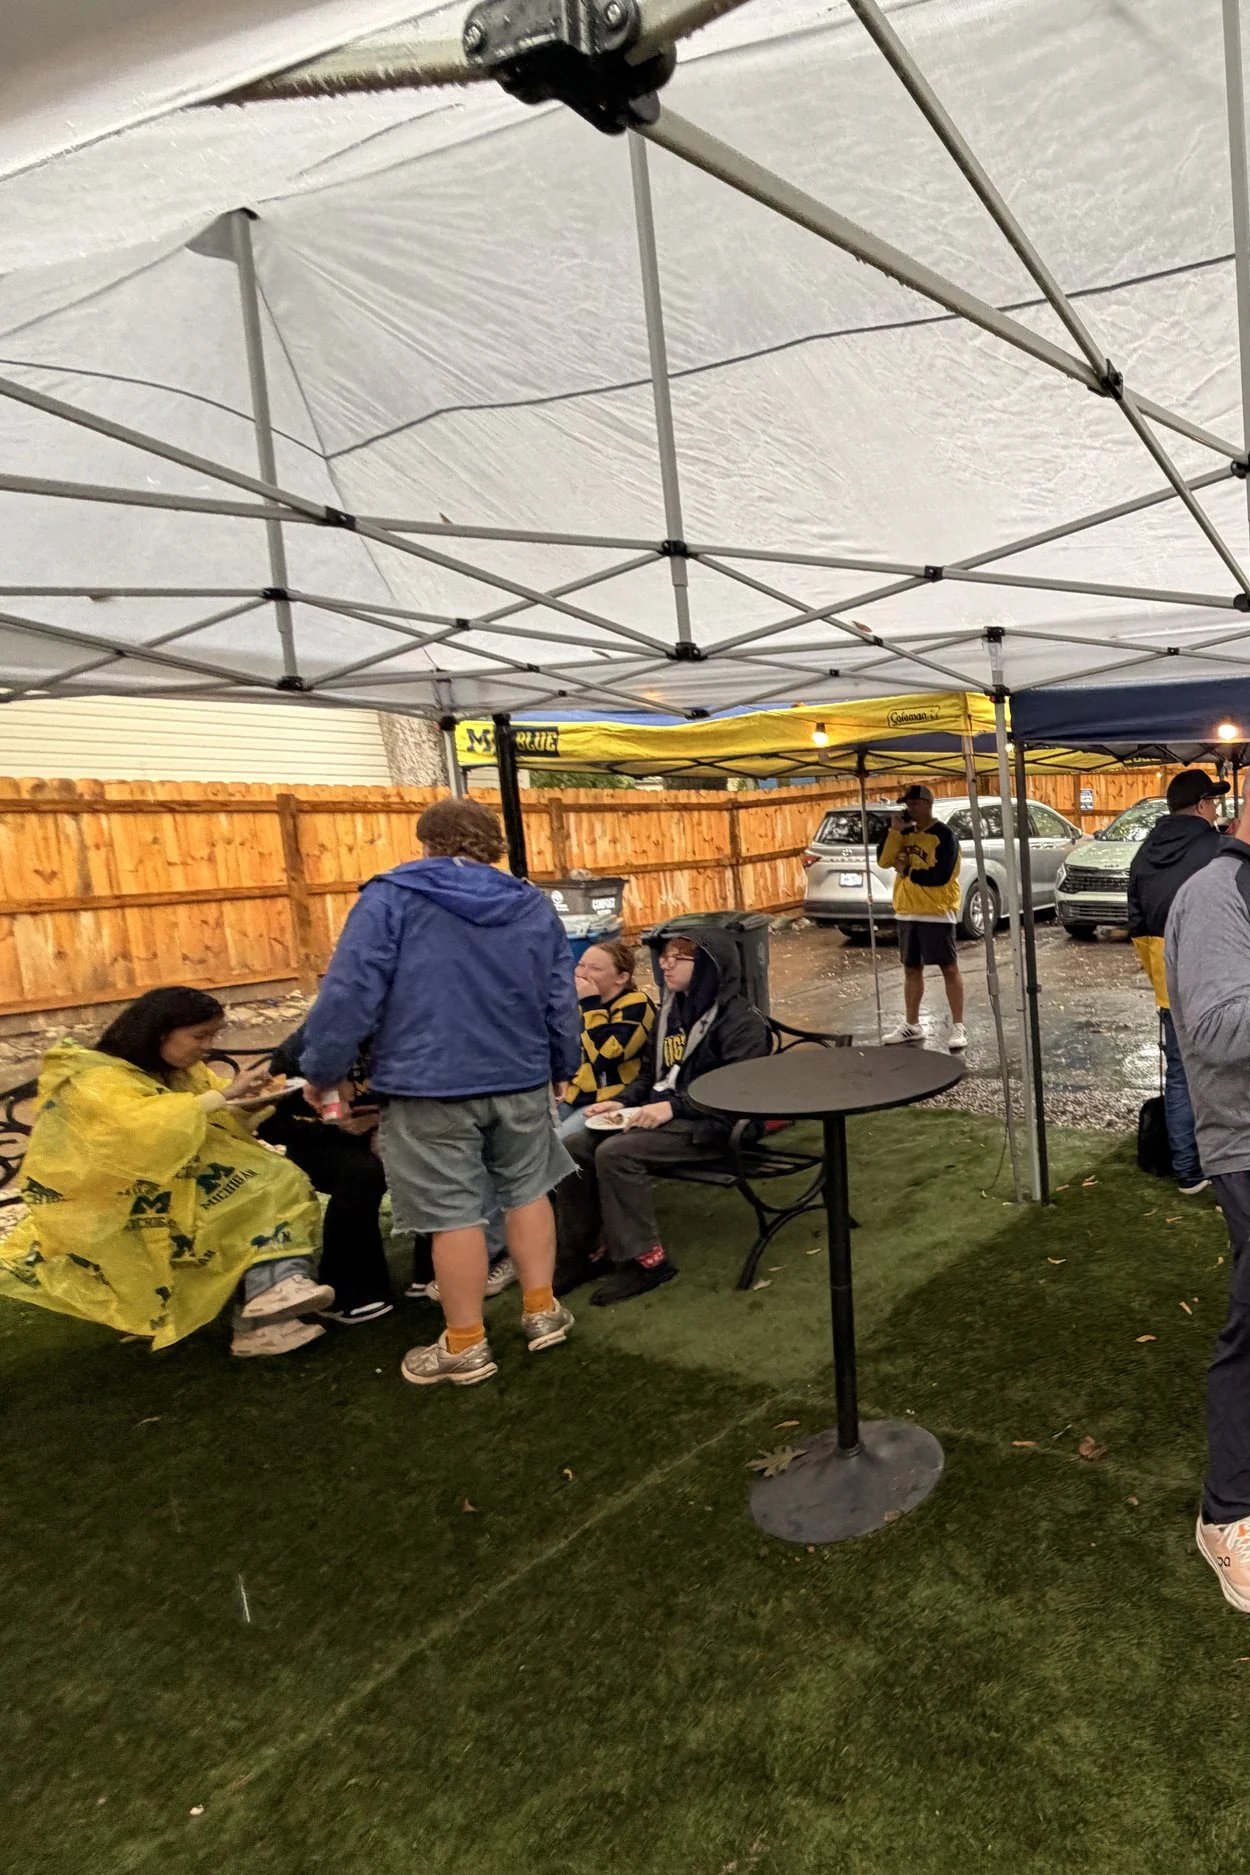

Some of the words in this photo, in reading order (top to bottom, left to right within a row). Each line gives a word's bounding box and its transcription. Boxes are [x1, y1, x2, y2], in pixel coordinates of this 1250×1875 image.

[890, 711, 928, 724] Coleman
[466, 728, 491, 752] M
[515, 731, 558, 752] BLUE
[200, 1168, 258, 1210] MICHIGAN
[130, 1190, 172, 1214] M
